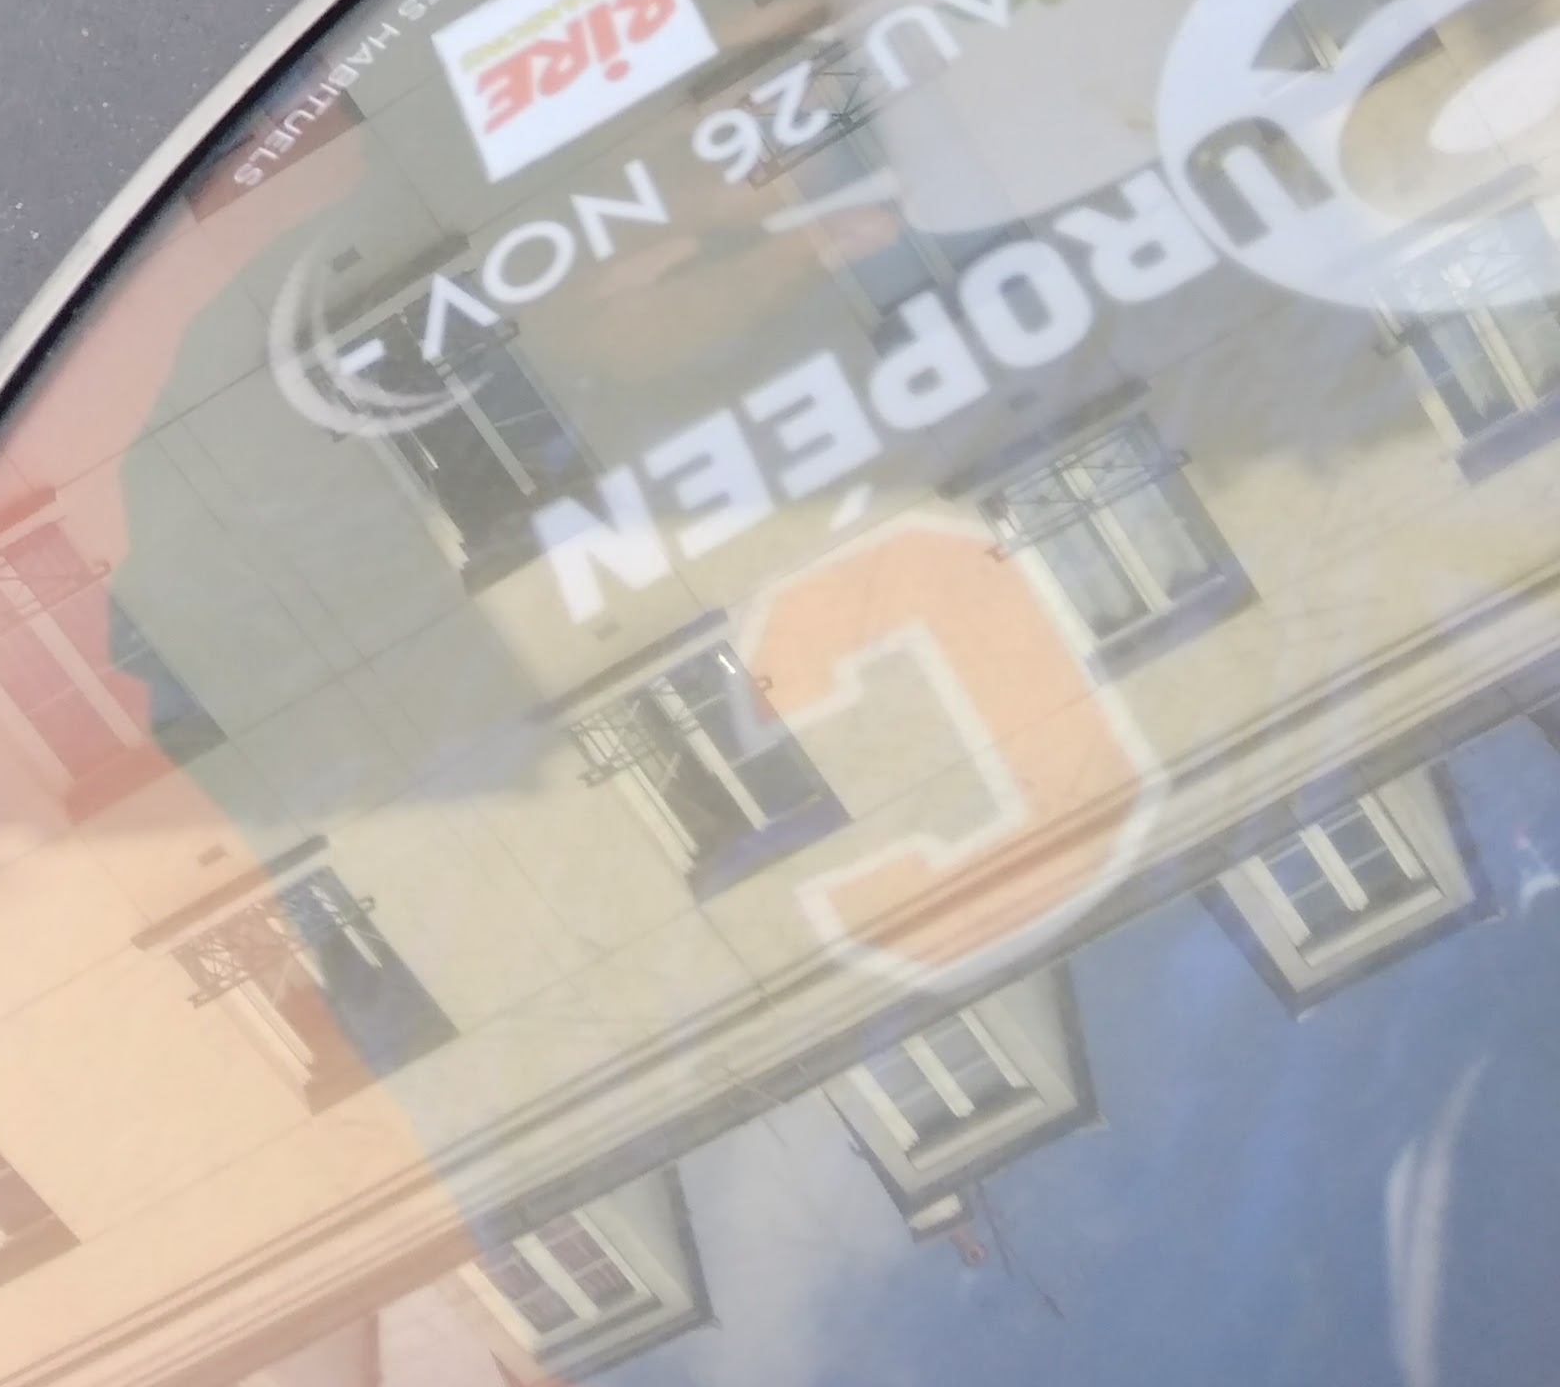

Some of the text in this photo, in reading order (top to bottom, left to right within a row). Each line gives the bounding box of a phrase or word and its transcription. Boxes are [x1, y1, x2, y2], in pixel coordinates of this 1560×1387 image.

[233, 22, 402, 189] HABITUELS
[691, 60, 834, 186] 26
[420, 159, 671, 363] NOV
